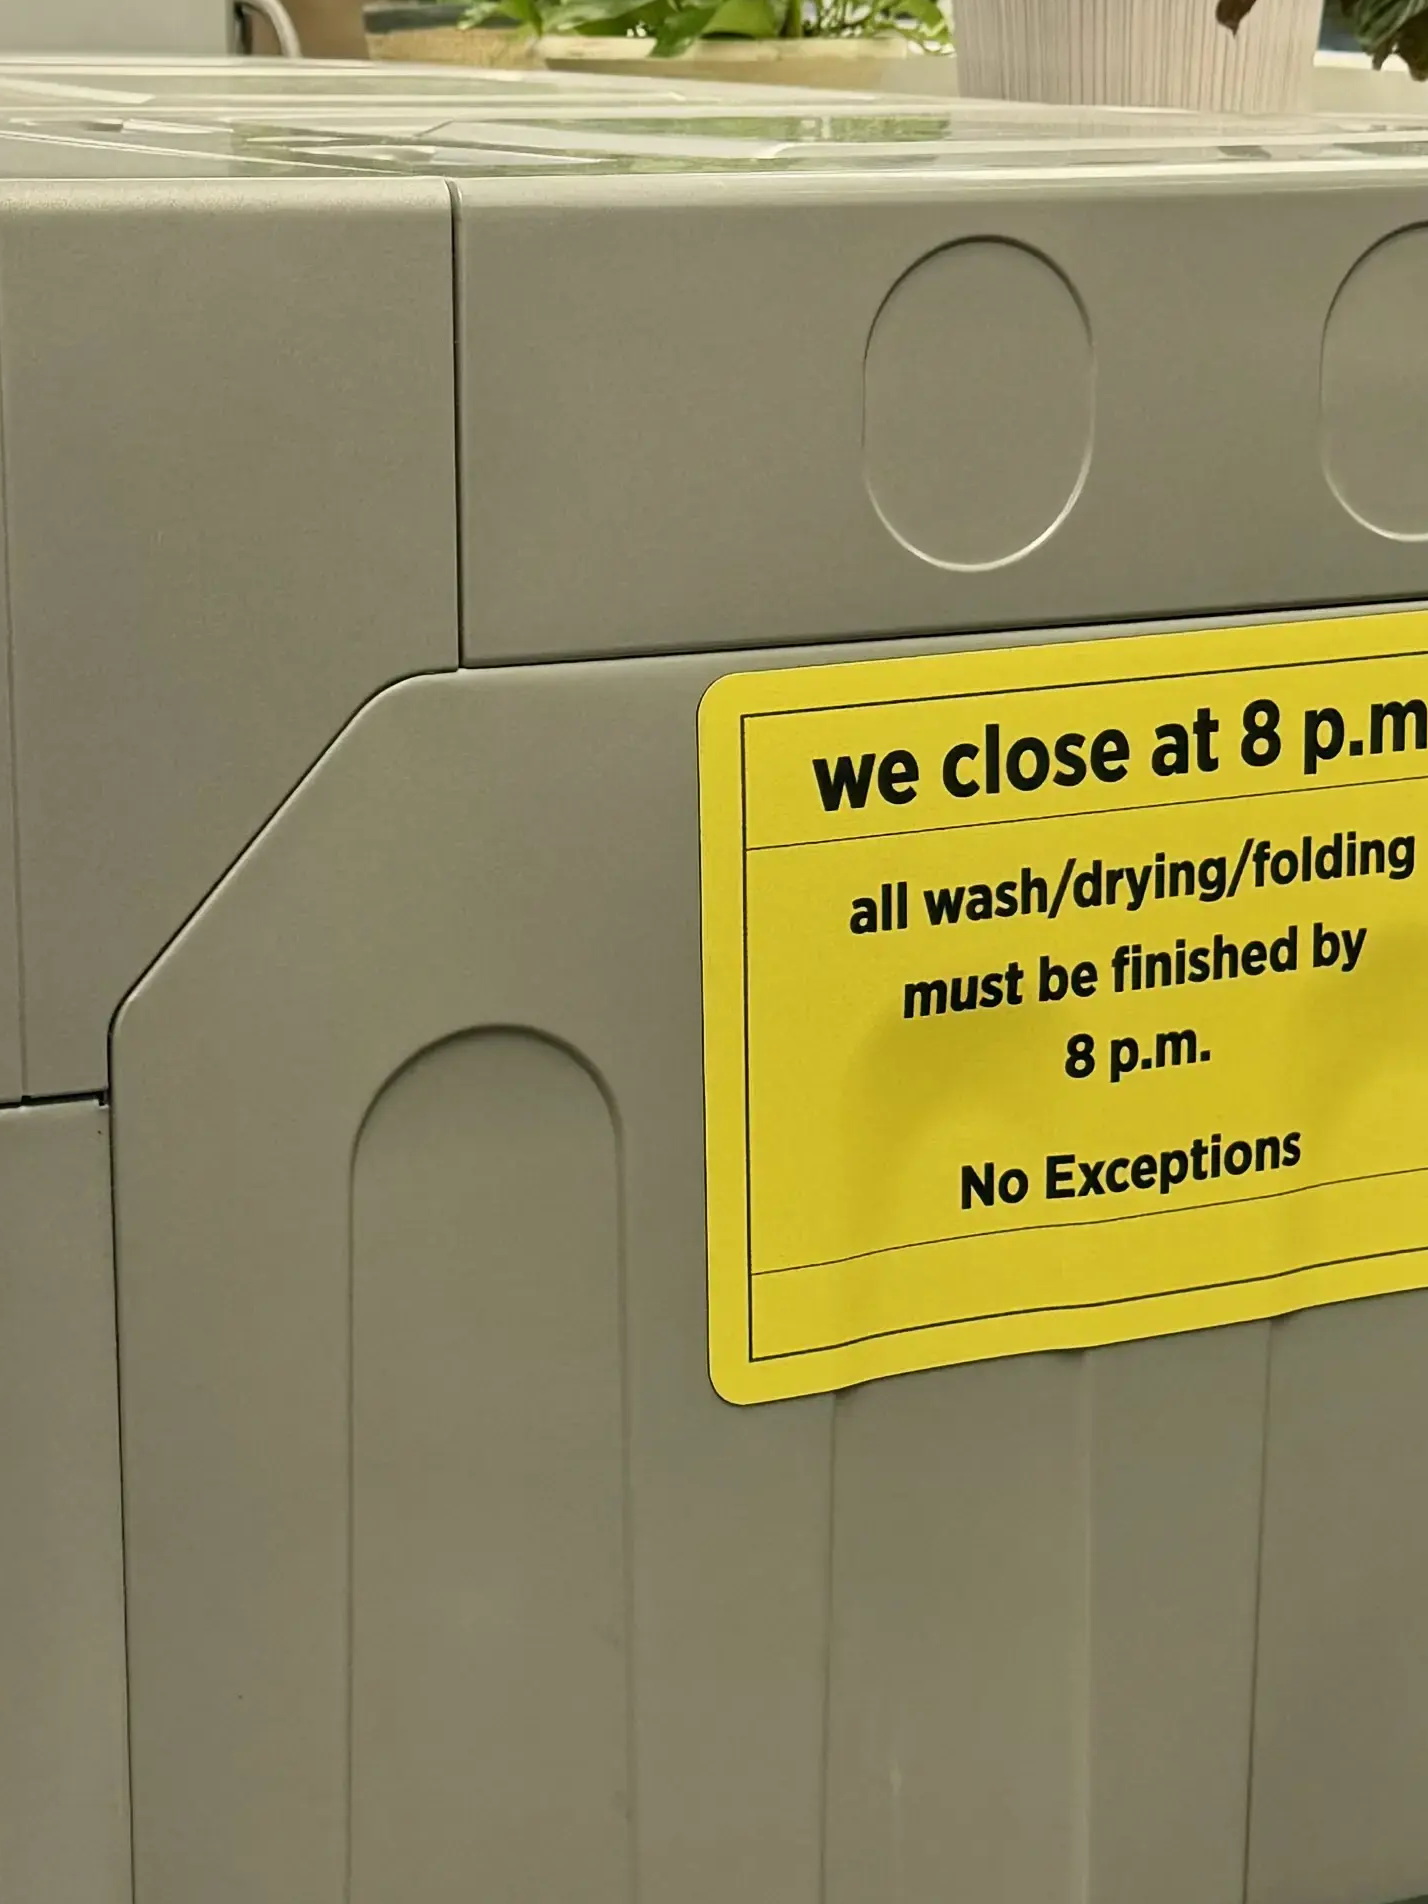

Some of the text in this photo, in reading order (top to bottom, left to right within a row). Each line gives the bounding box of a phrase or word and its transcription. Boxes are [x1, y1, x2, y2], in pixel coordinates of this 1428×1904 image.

[812, 749, 921, 812] we
[942, 723, 1130, 798] close
[1151, 707, 1220, 777] at
[1240, 698, 1282, 767] 8
[849, 831, 1416, 935] all wash/drying/folding
[903, 922, 1367, 1019] must be finished by
[1064, 1029, 1211, 1083] 8 p.m.
[961, 1131, 1301, 1210] No Exceptions
